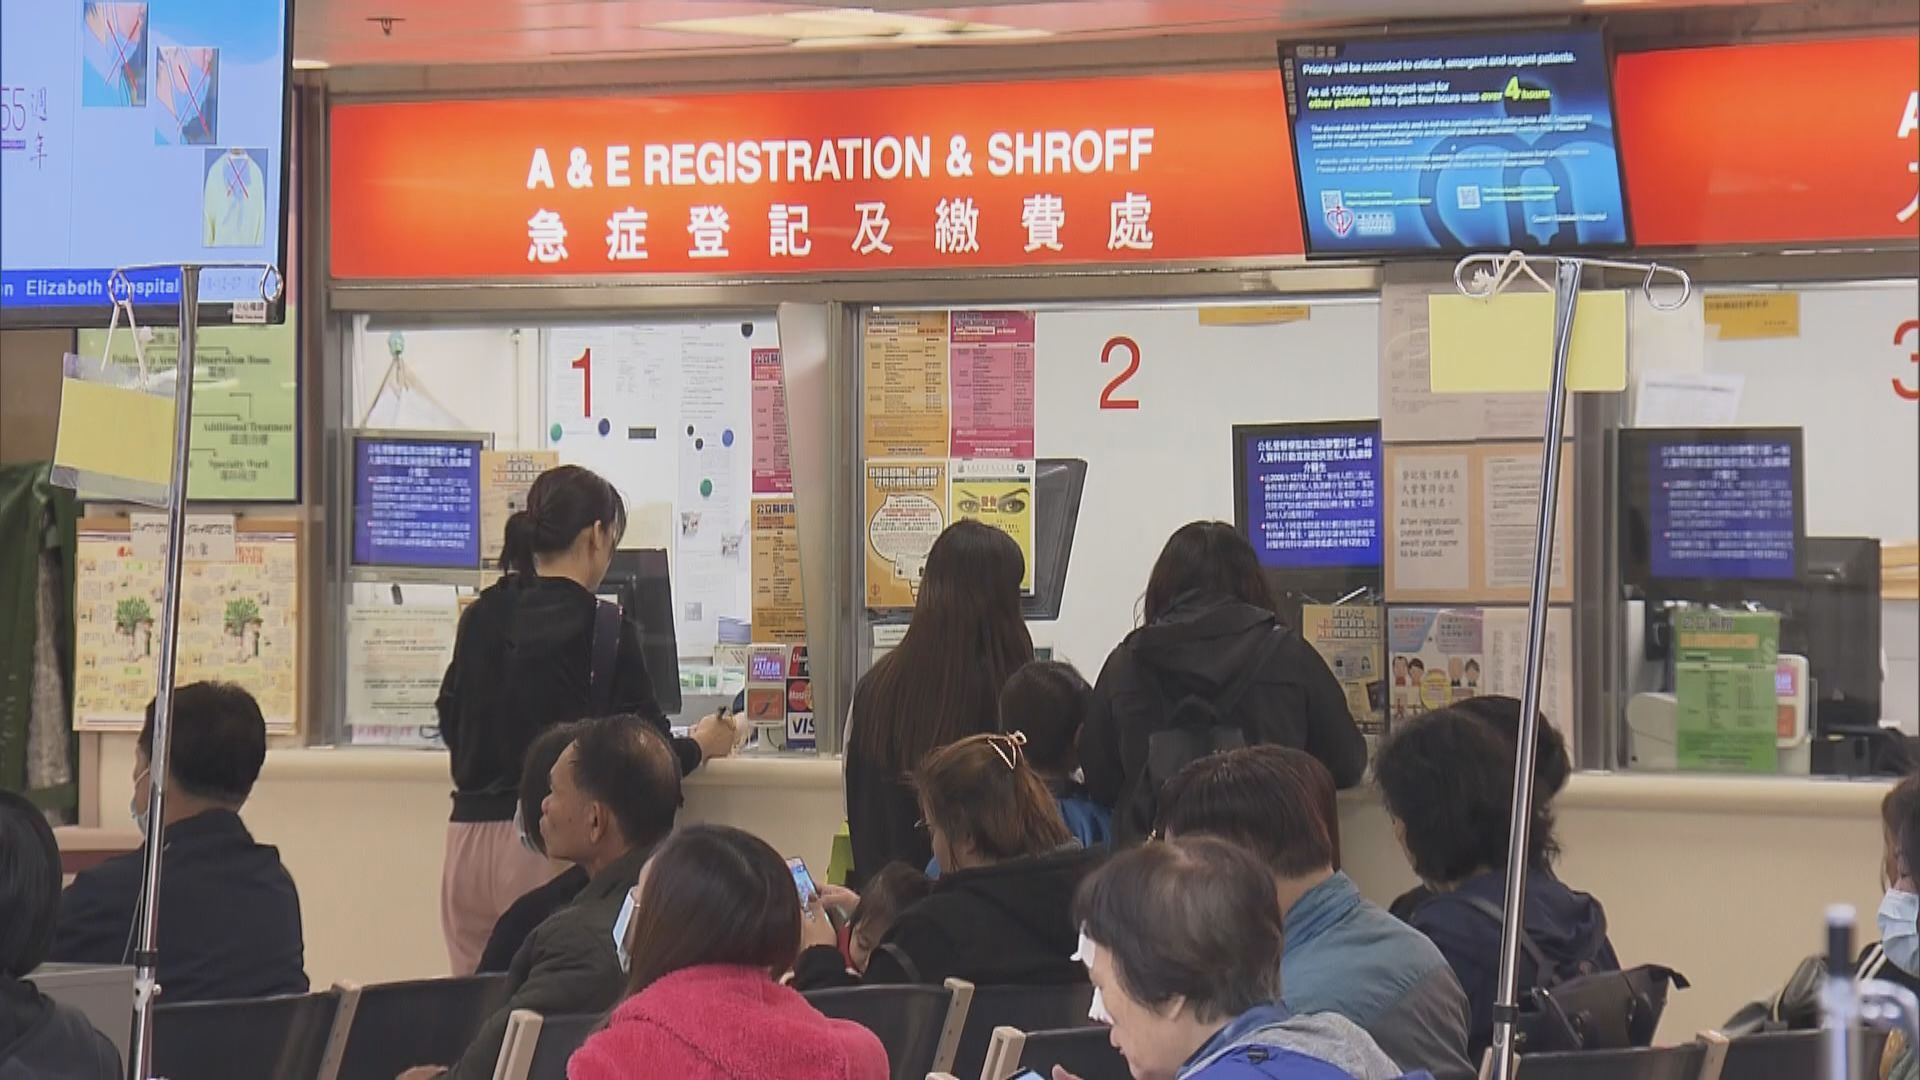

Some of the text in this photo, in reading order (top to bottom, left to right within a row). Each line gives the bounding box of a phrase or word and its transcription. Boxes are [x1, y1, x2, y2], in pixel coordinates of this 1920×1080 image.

[1302, 63, 1332, 76] Priority
[1334, 62, 1348, 73] will
[1350, 62, 1361, 73] be
[1403, 60, 1412, 70] to
[1489, 55, 1506, 66] and
[1507, 54, 1536, 67] urgent
[1307, 86, 1319, 96] As
[1320, 86, 1330, 96] at
[1369, 84, 1383, 94] the
[1384, 83, 1417, 96] longest
[1436, 81, 1450, 92] for
[1308, 98, 1332, 109] other
[1334, 97, 1371, 110] patients
[1382, 95, 1396, 105] the
[1397, 95, 1416, 108] past
[1435, 92, 1460, 103] hours
[1462, 93, 1479, 102] was
[1481, 91, 1503, 101] over
[1504, 76, 1521, 100] 4
[527, 128, 1154, 189] A & E REGISTRATION & SHROFF
[527, 192, 1154, 263] 急症登記及繳費處
[26, 279, 102, 296] Elizabeth
[572, 348, 591, 418] 1
[1100, 336, 1140, 409] 2
[1892, 319, 1919, 400] 3
